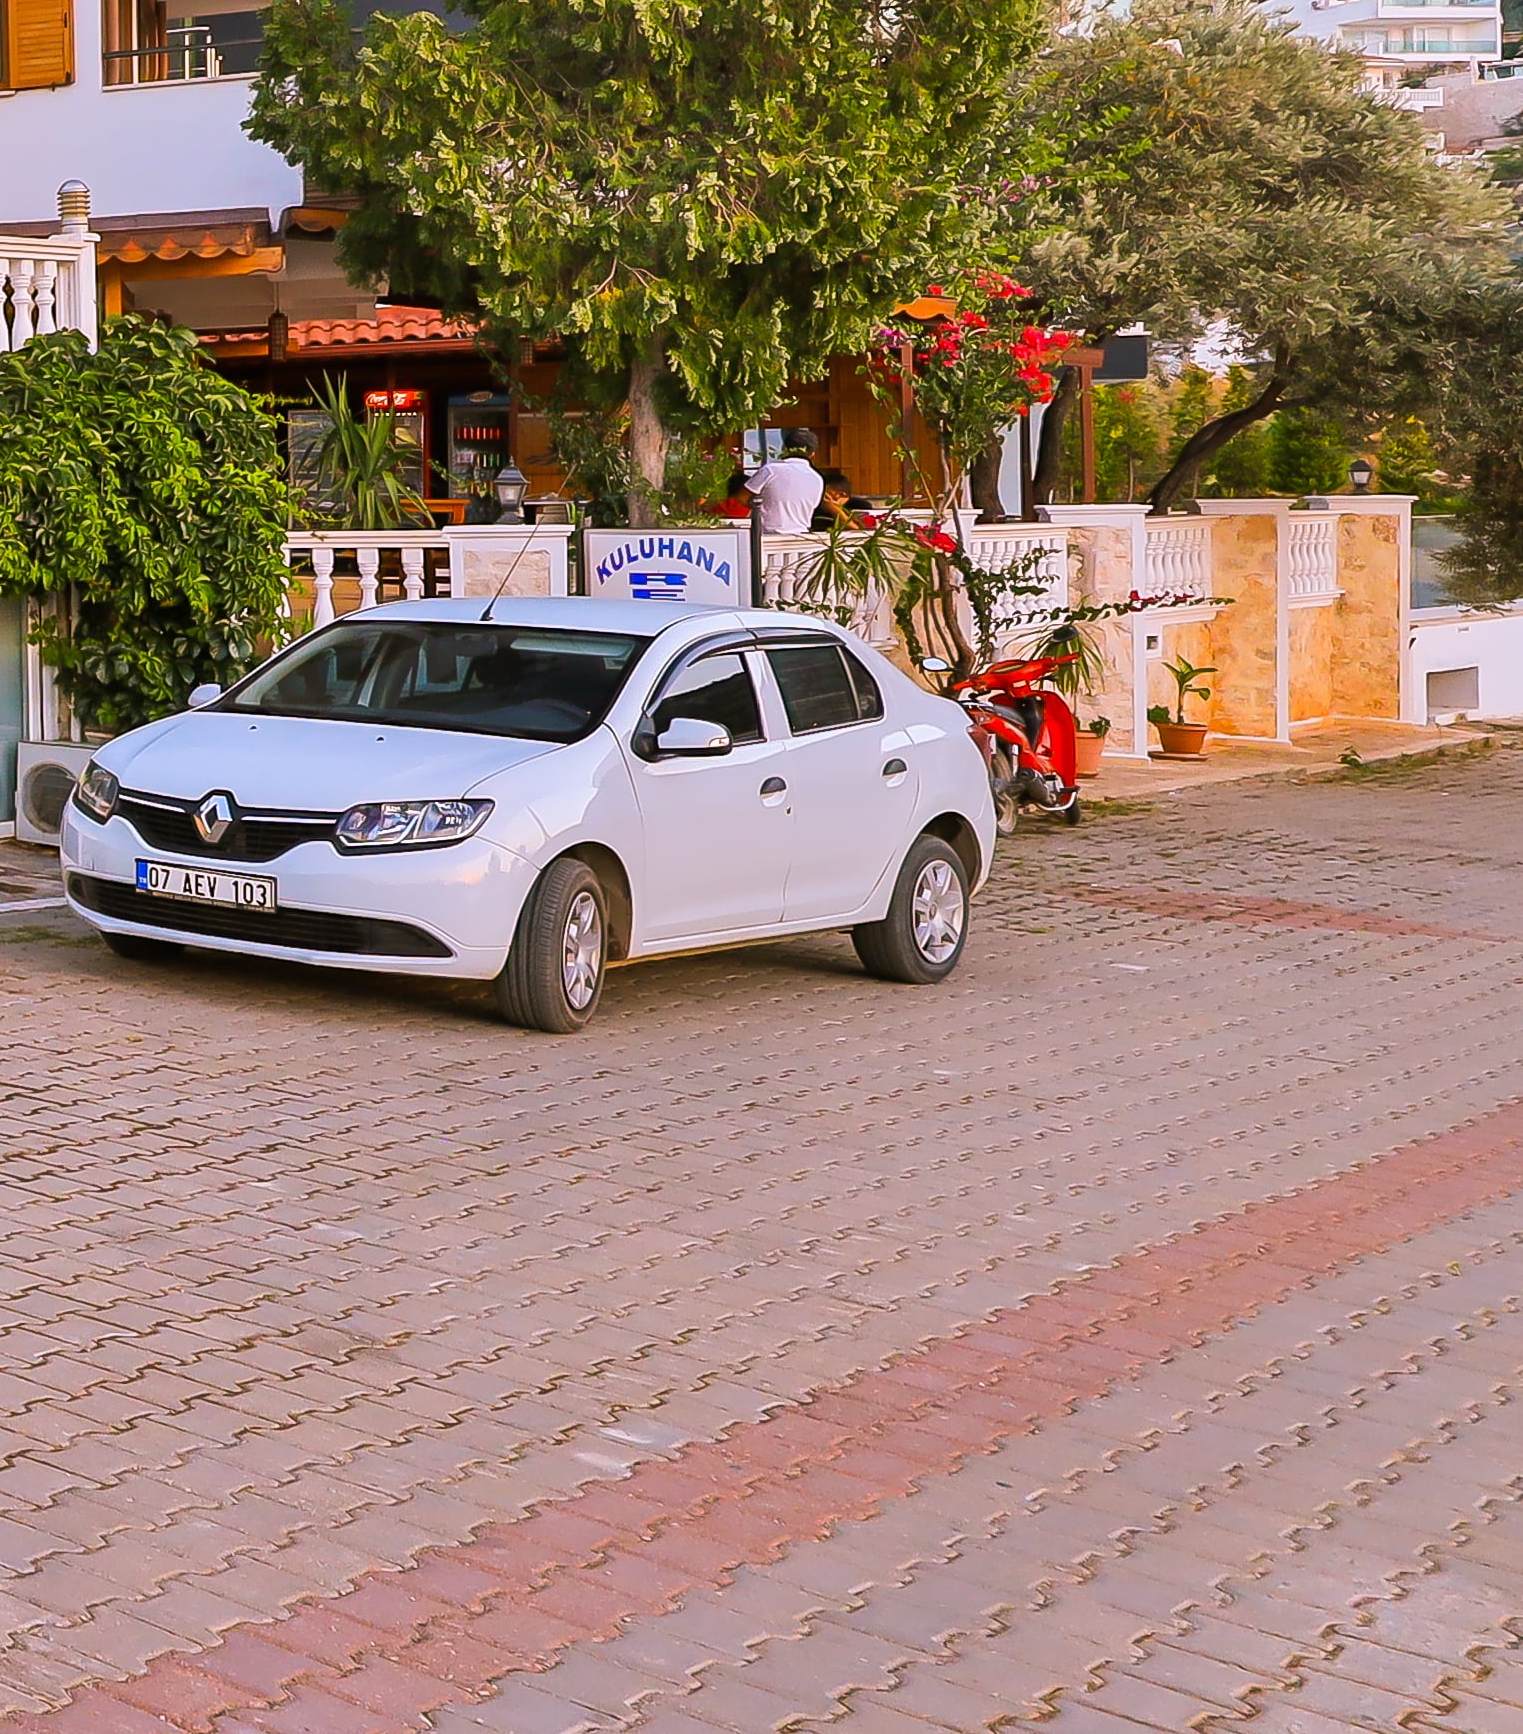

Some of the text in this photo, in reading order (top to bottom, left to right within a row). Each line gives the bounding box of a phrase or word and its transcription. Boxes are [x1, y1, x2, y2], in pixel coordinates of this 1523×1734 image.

[596, 537, 731, 587] KULUHANA
[149, 867, 170, 889] 07
[183, 873, 217, 898] AEV
[232, 880, 267, 906] 103
